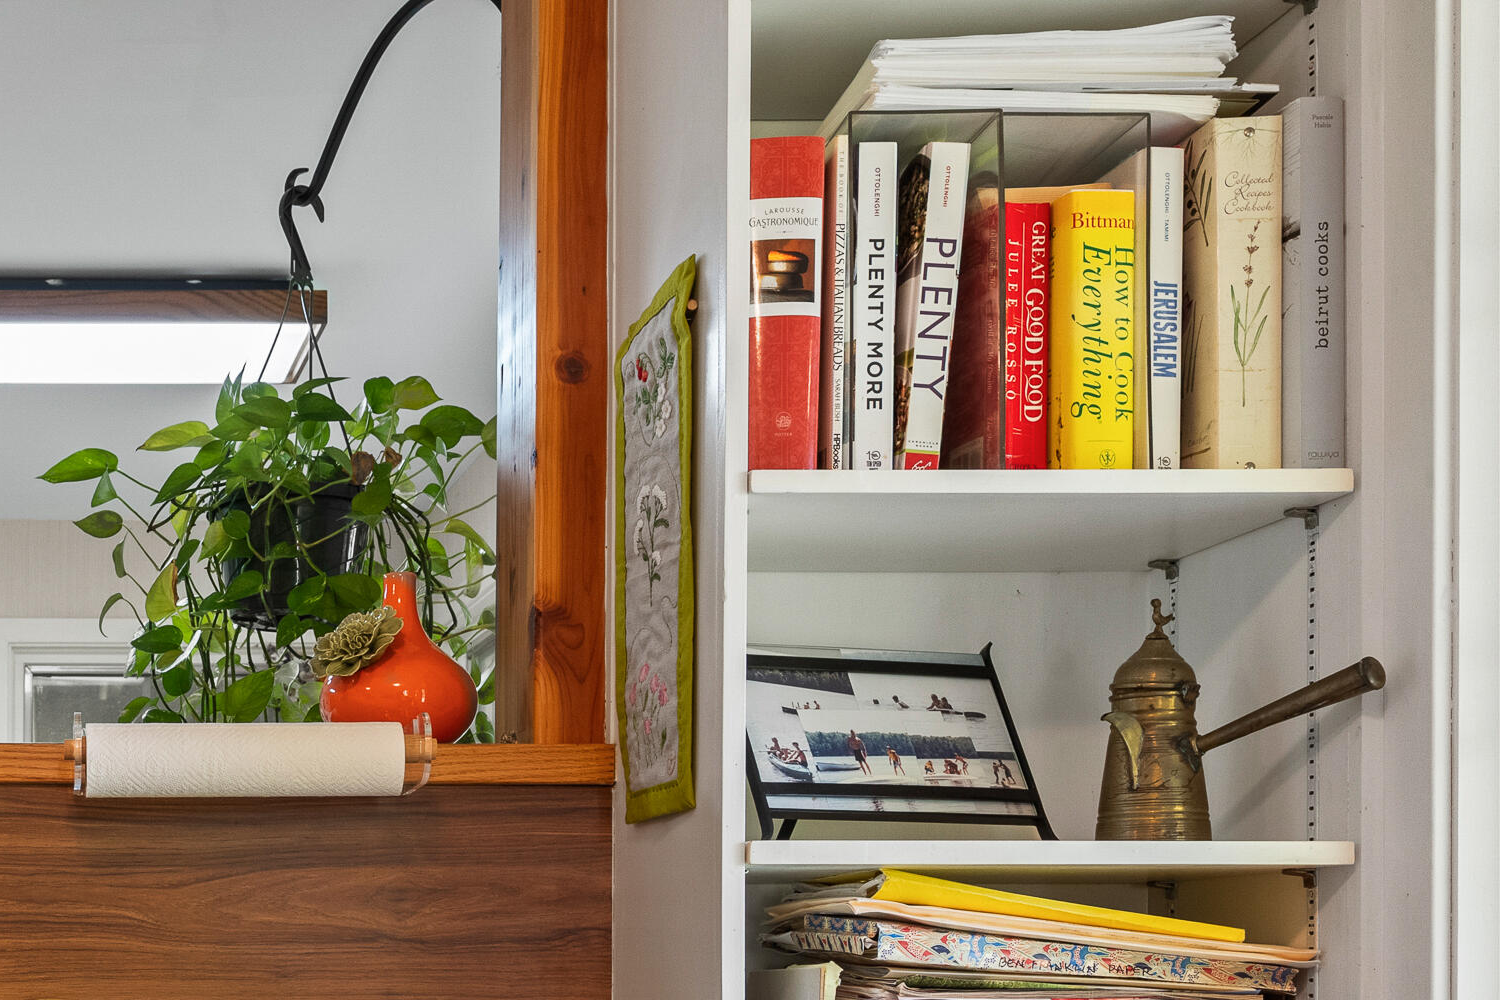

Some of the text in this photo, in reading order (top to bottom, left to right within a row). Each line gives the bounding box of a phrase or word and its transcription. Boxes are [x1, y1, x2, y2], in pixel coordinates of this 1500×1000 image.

[942, 165, 951, 208] OTTOLENGHI
[1224, 170, 1274, 188] Collected
[1234, 184, 1274, 201] Recipes
[748, 217, 819, 229] GASTRONOMIQUE
[764, 207, 805, 215] LAROUSSE
[1070, 212, 1134, 230] Bittman
[1223, 198, 1275, 215] Cookbook
[834, 223, 846, 265] PIZZAS
[833, 279, 845, 323] ITALIAN
[1314, 221, 1329, 349] beirut cooks
[866, 238, 885, 410] PLENTY MORE
[913, 237, 958, 401] PLENTY
[1006, 239, 1020, 400] JULEE ROSSO
[1024, 221, 1046, 423] GREAT GOOD FOOD
[1071, 241, 1113, 421] Everything
[1114, 244, 1134, 422] How to Cook
[1152, 280, 1178, 378] JERUSALEM
[832, 326, 844, 371] BREADS
[832, 433, 841, 470] HPBooks
[998, 956, 1026, 969] BEN
[1107, 964, 1155, 977] PAPER
